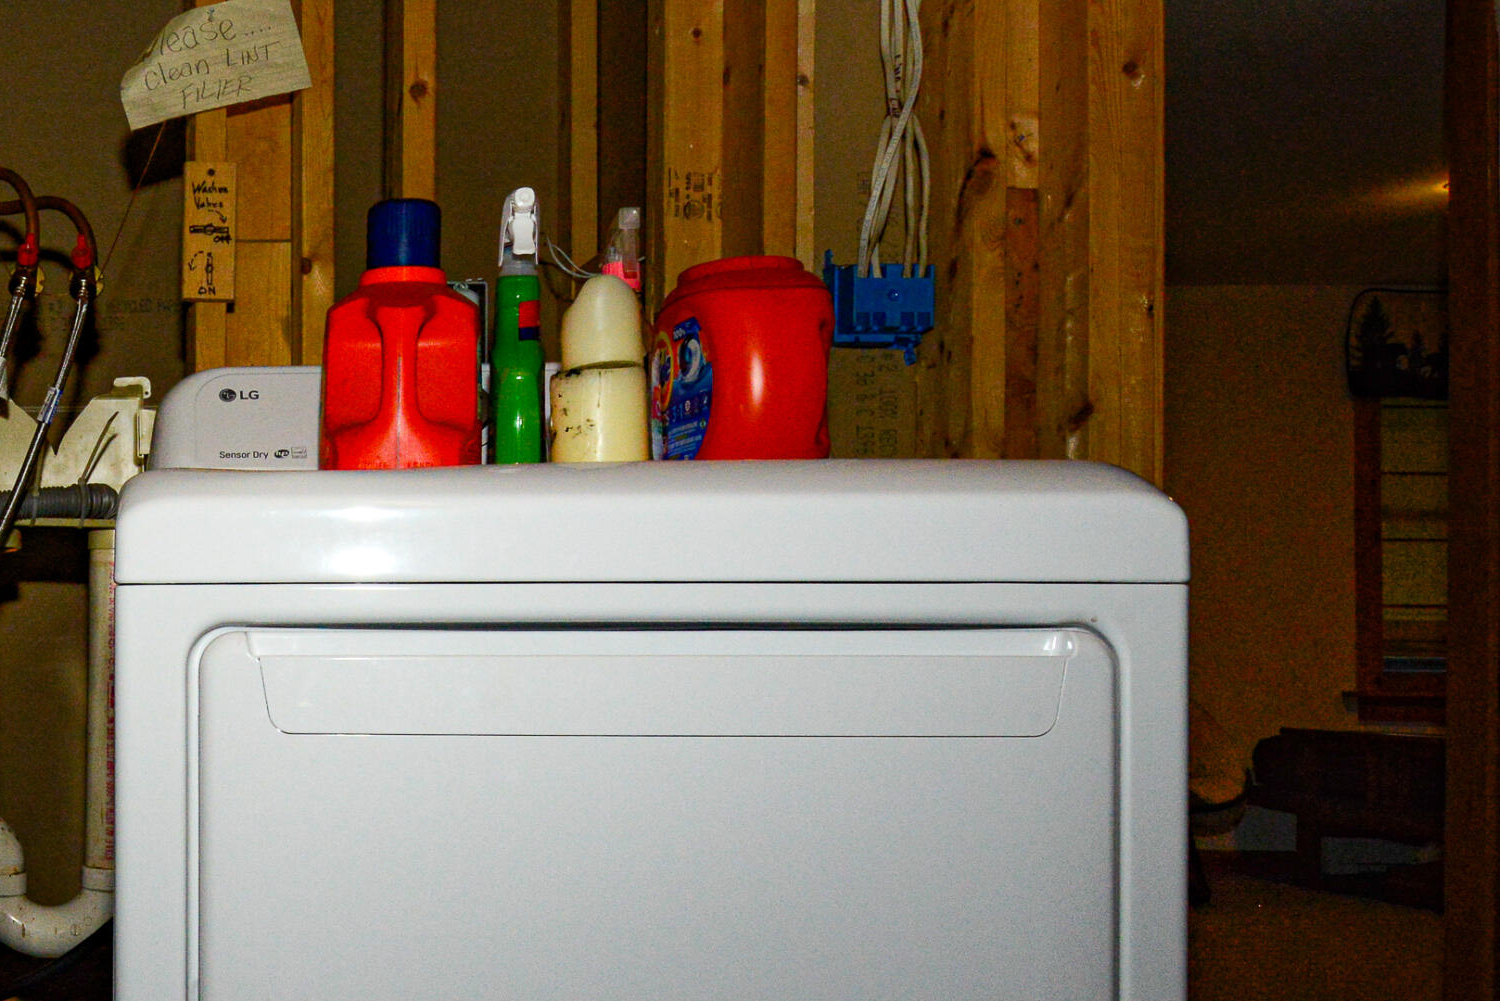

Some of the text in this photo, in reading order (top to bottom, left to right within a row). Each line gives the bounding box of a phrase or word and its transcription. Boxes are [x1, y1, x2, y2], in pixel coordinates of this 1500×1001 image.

[198, 285, 216, 296] ON
[239, 390, 260, 400] LG
[219, 450, 269, 459] Sensor Dry
